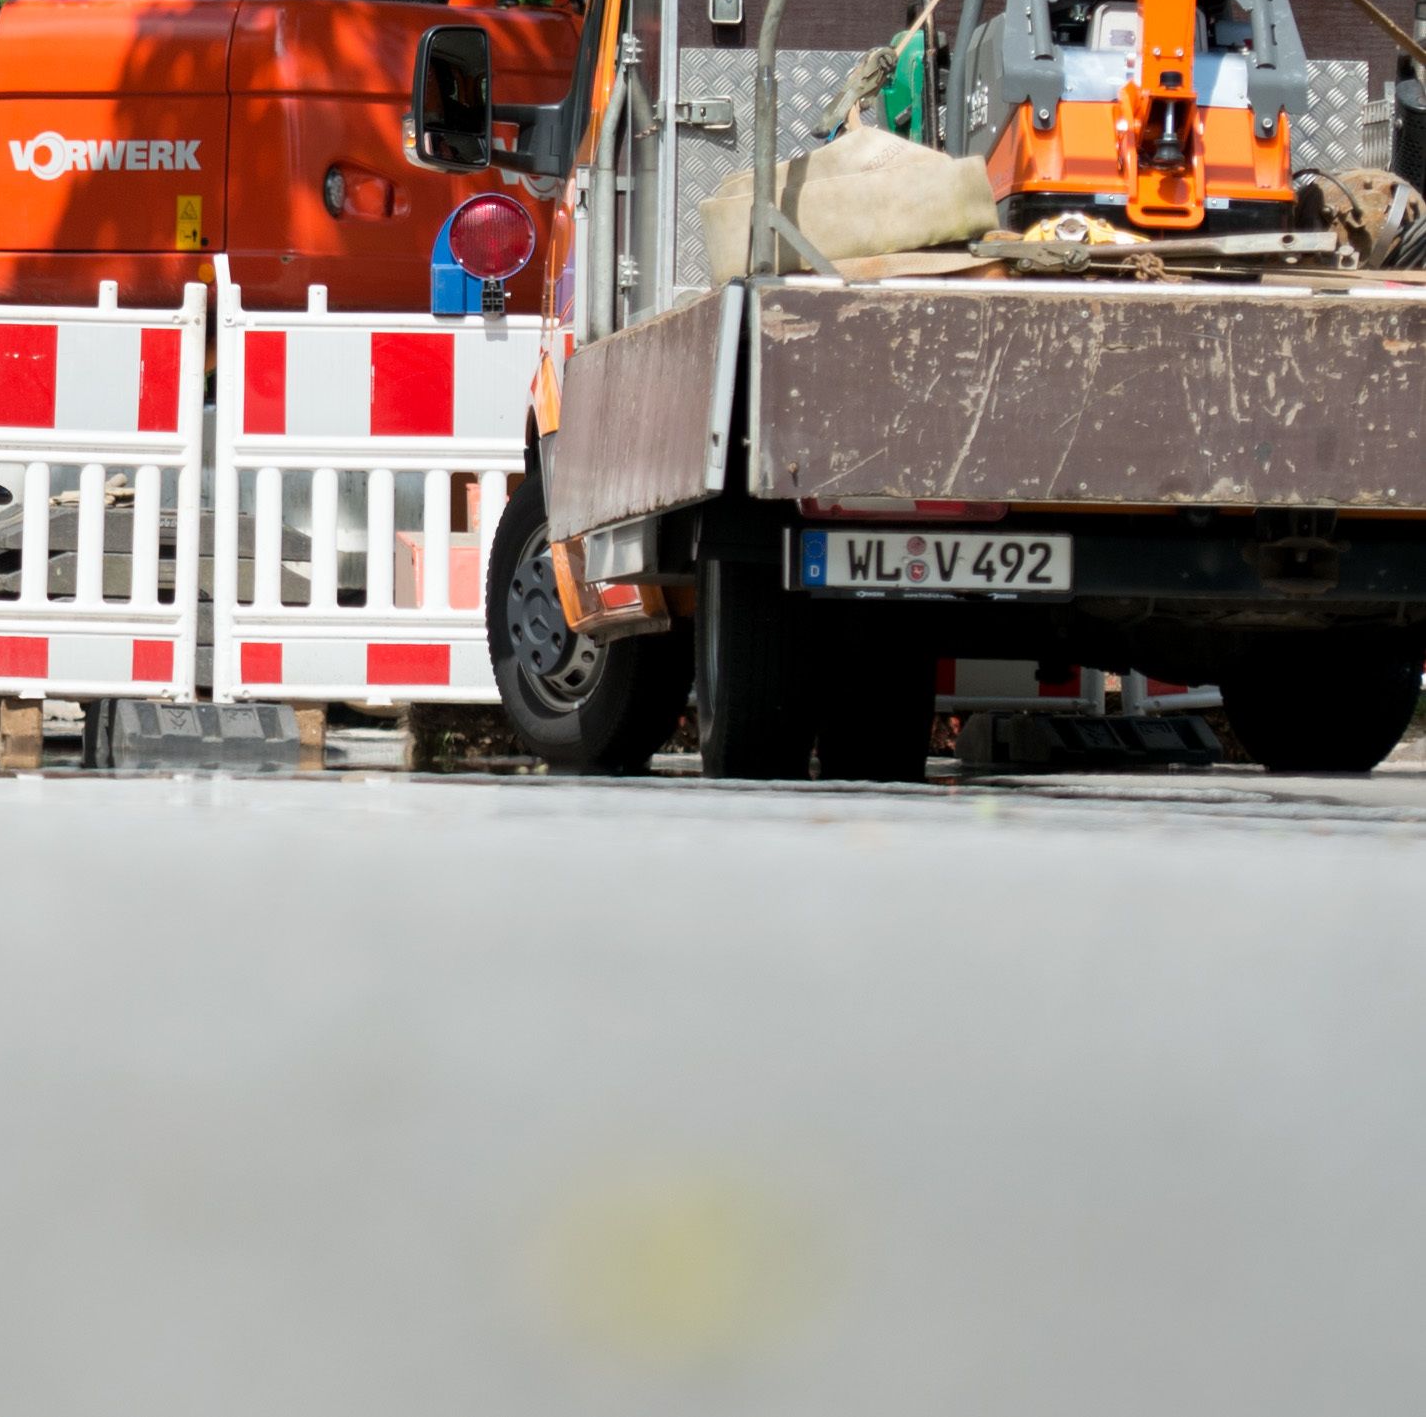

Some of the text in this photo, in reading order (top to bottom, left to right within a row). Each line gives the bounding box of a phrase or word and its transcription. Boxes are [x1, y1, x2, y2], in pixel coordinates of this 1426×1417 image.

[8, 131, 201, 181] VORWERK
[848, 540, 1053, 583] WL V 492
